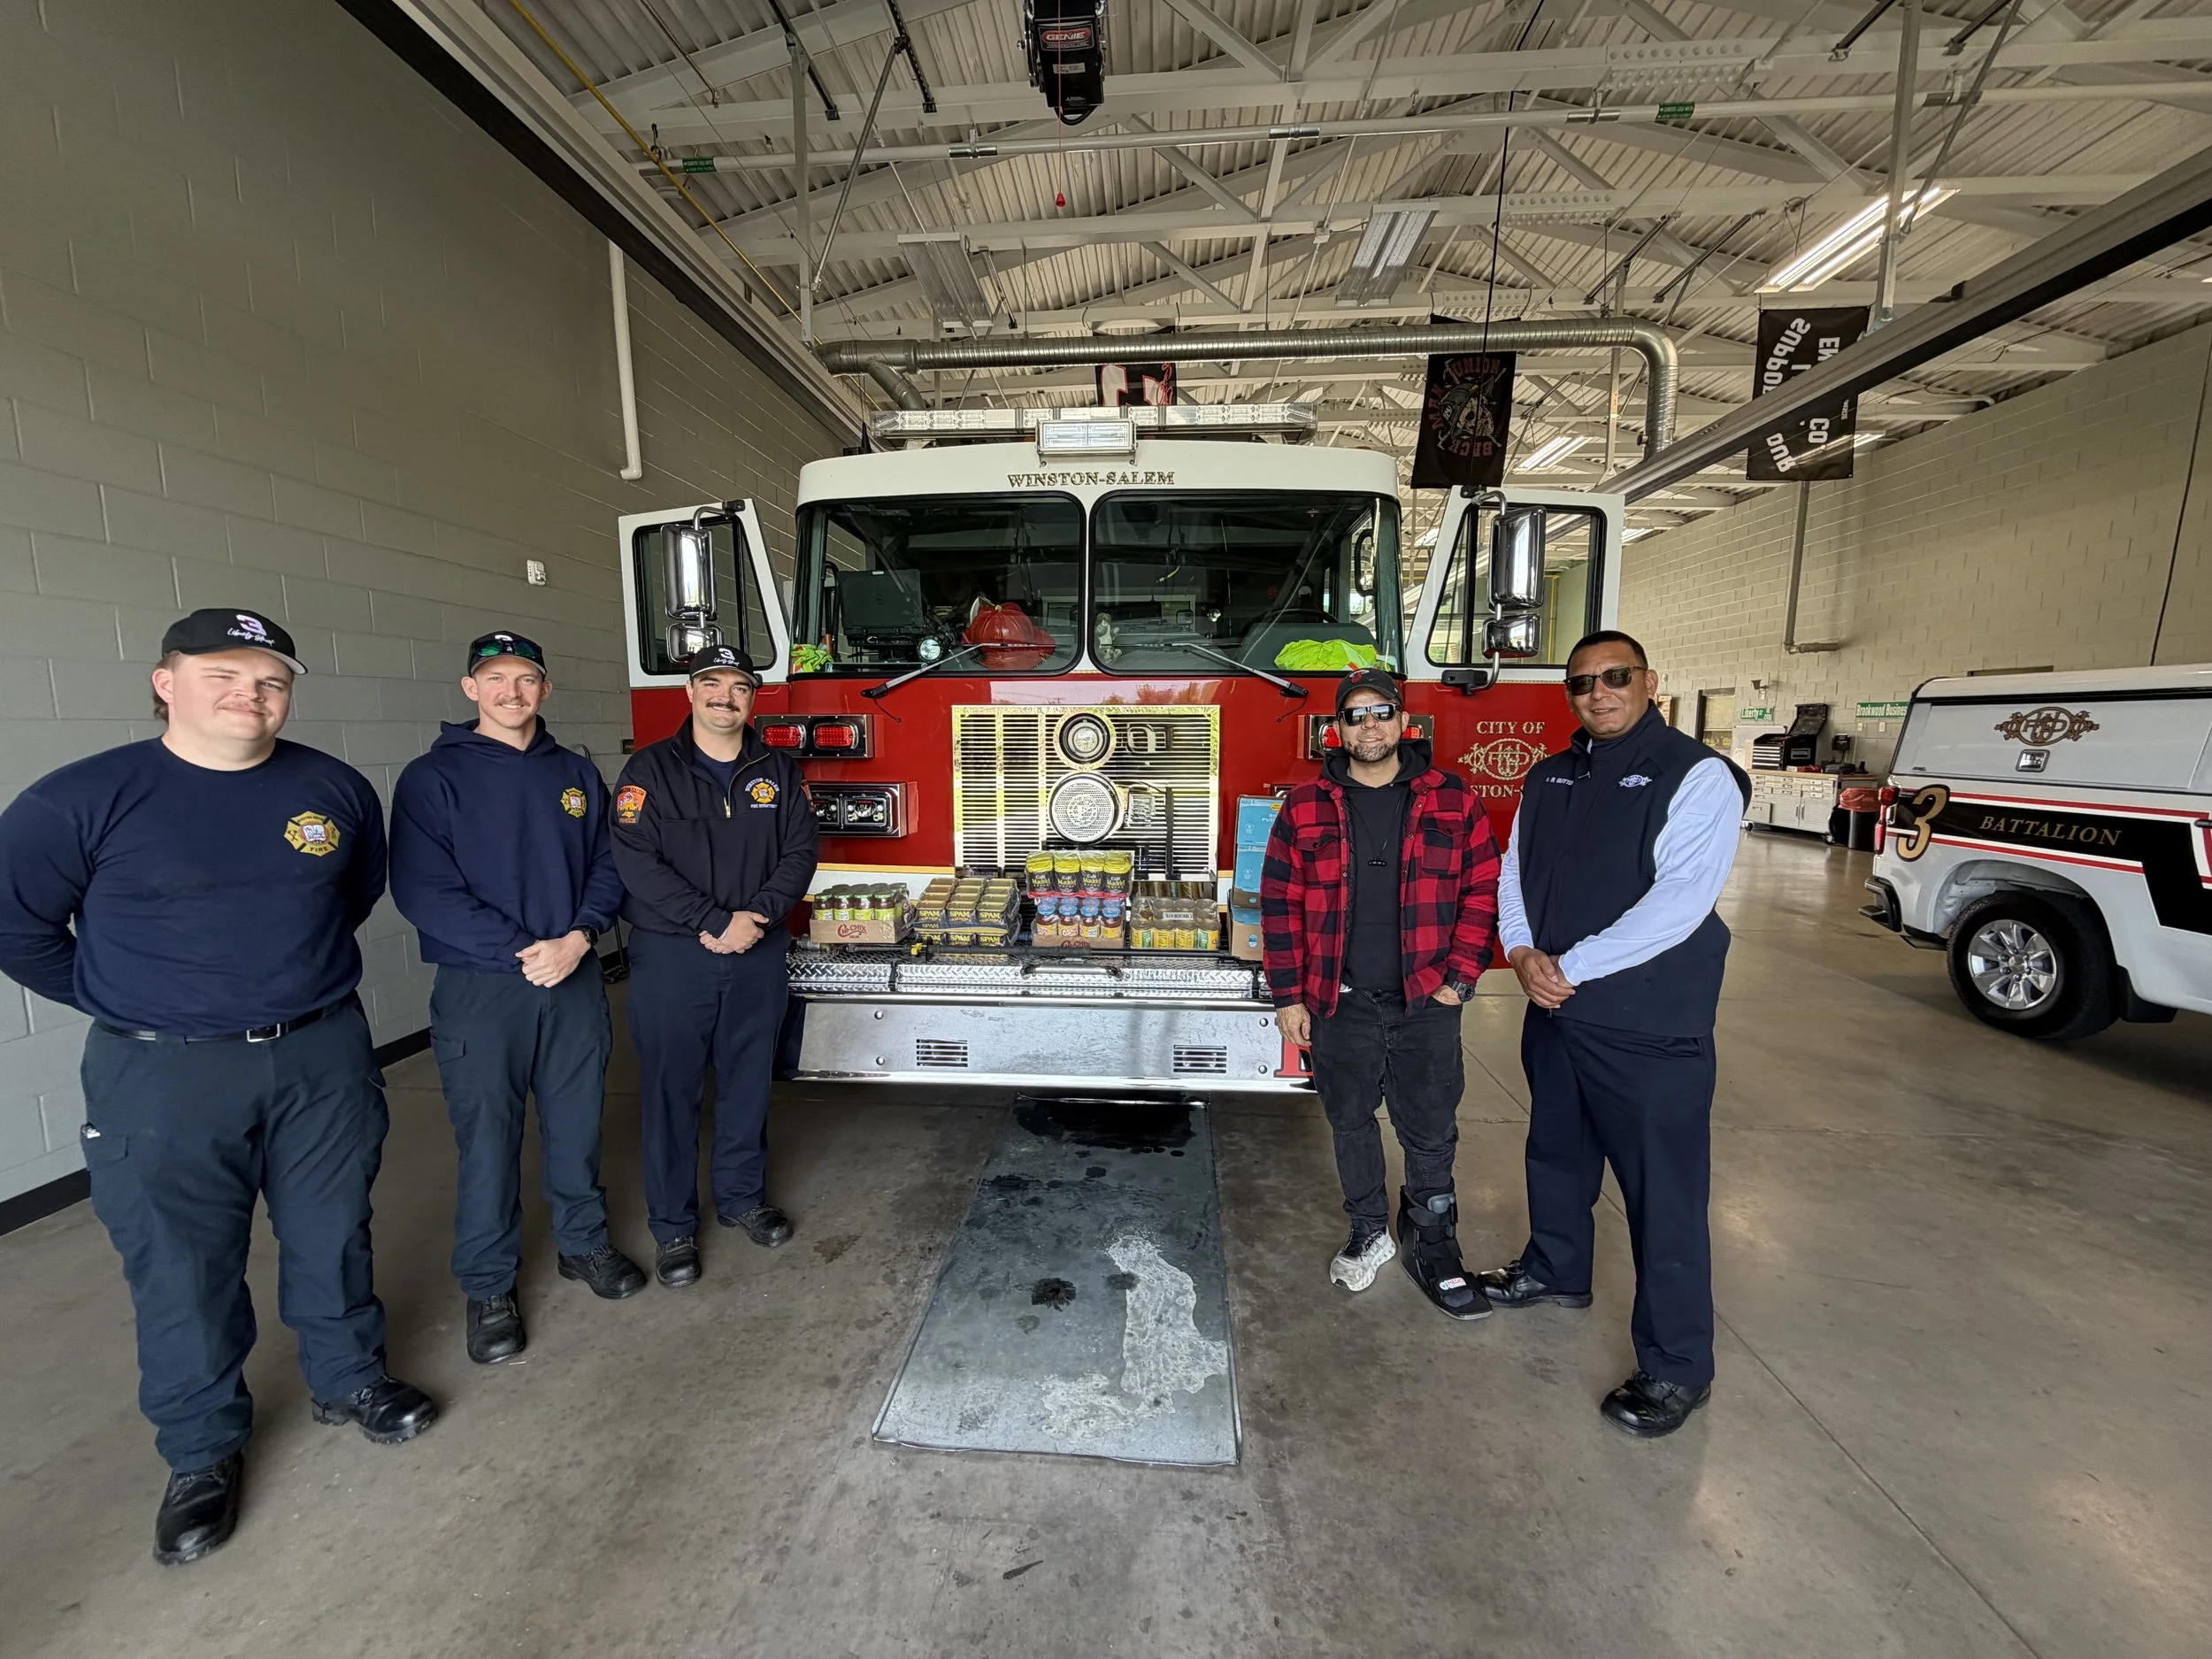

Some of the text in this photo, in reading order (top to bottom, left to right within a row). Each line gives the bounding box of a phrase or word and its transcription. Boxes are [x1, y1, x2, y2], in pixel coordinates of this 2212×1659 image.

[1046, 31, 1087, 41] GENIE
[1007, 471, 1176, 488] WINSTON-SALEM
[1476, 720, 1545, 734] CITY OF
[1897, 785, 1949, 862] 3
[1978, 815, 2123, 847] BATTALION
